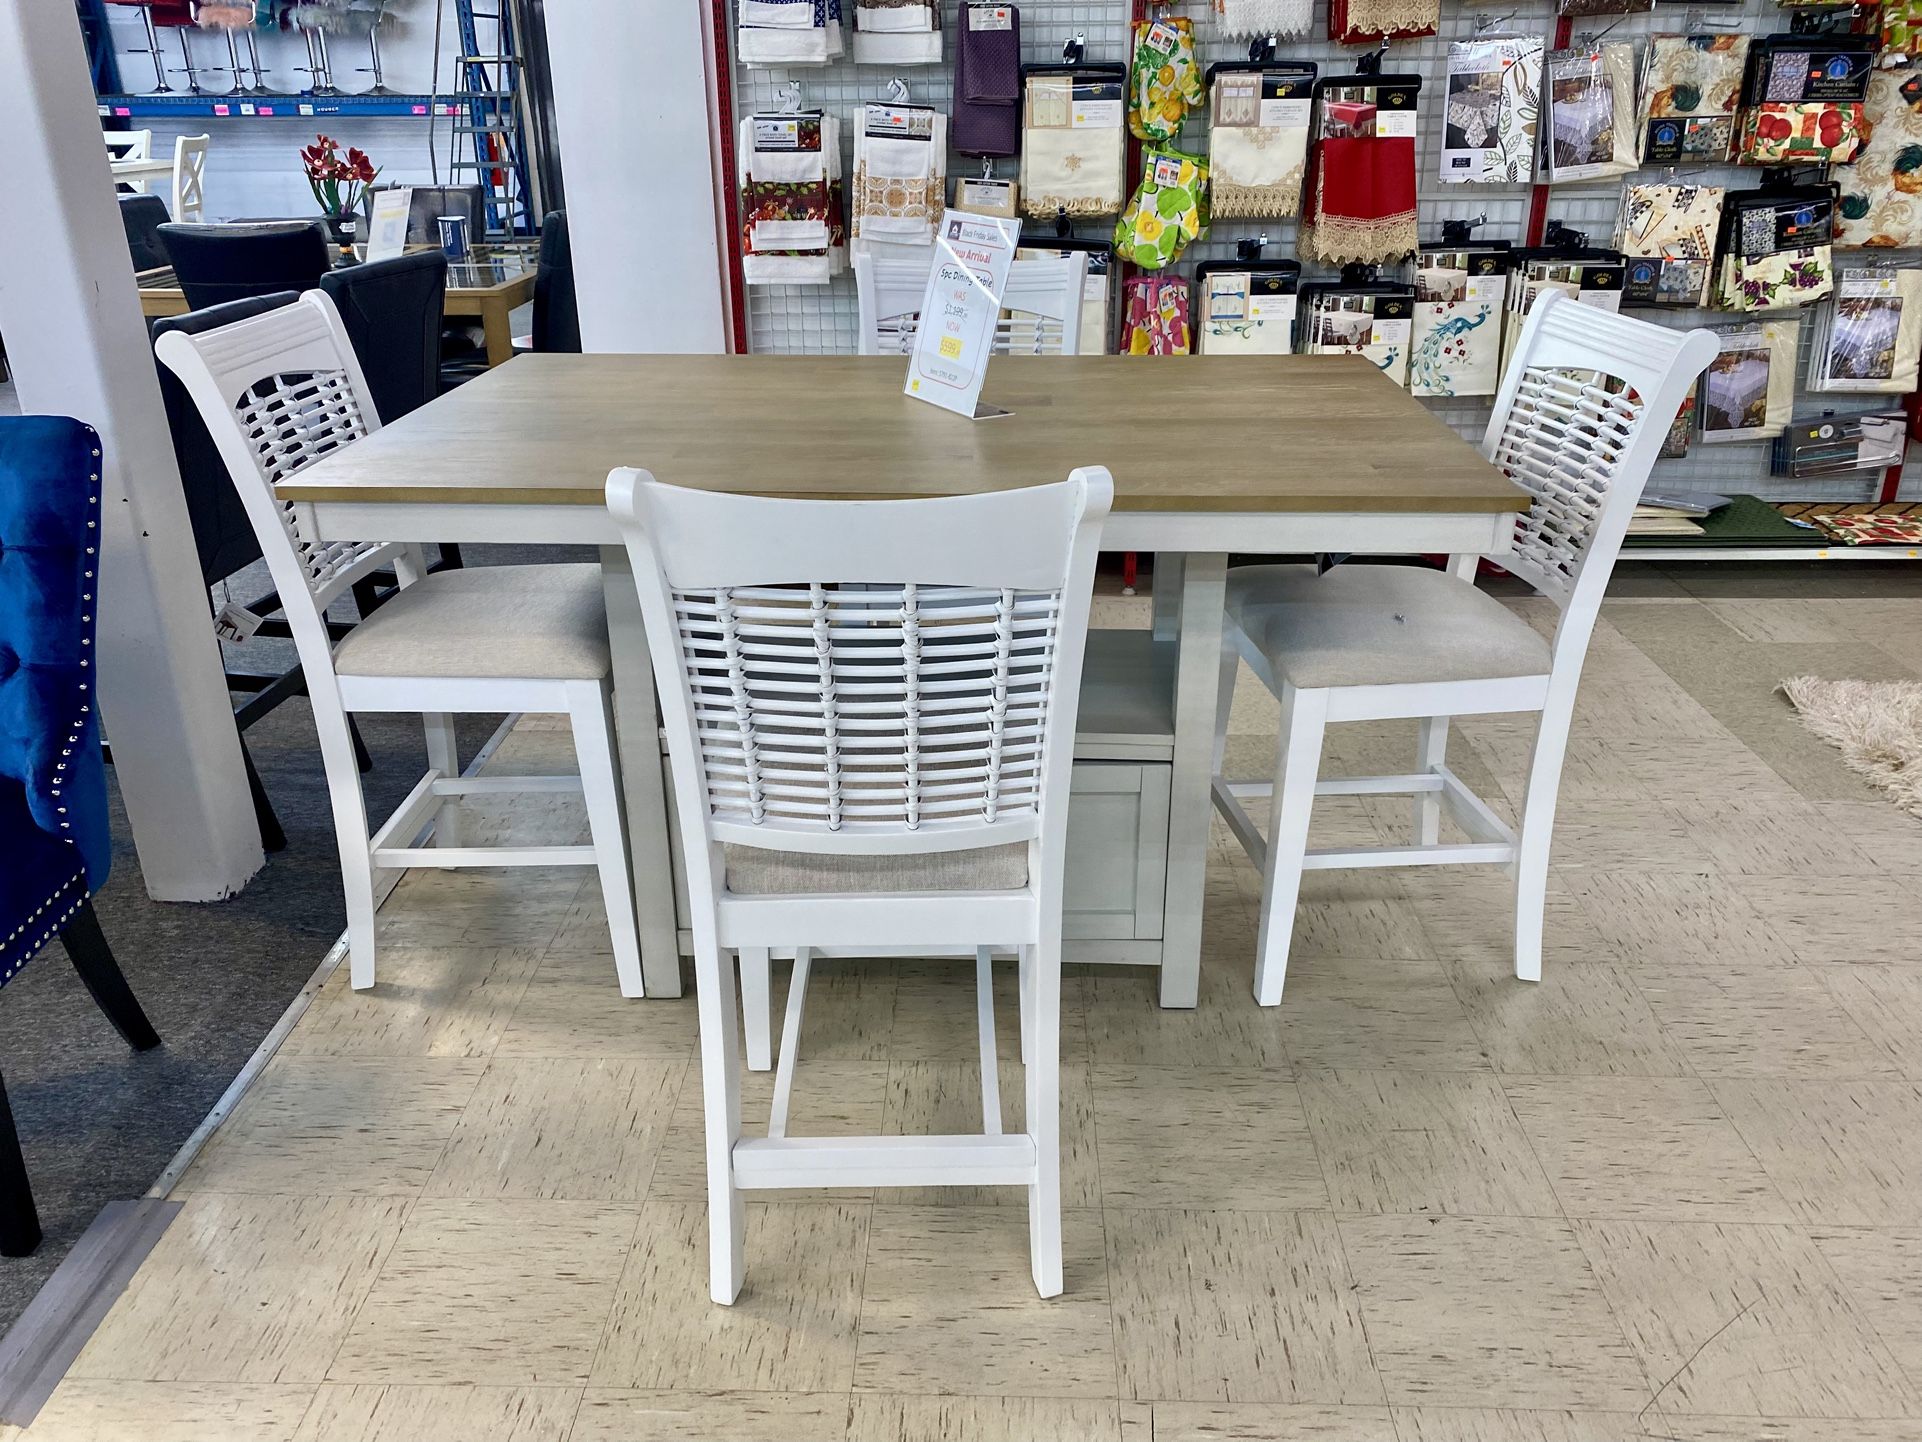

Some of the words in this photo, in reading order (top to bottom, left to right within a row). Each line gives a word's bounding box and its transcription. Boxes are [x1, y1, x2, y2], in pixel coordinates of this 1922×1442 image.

[973, 229, 986, 241] Friday
[986, 232, 998, 241] Sales
[966, 249, 992, 264] Arrival
[941, 268, 953, 280] 5pc
[953, 271, 974, 286] Dining
[953, 289, 967, 301] WAS
[946, 321, 960, 333] NOW
